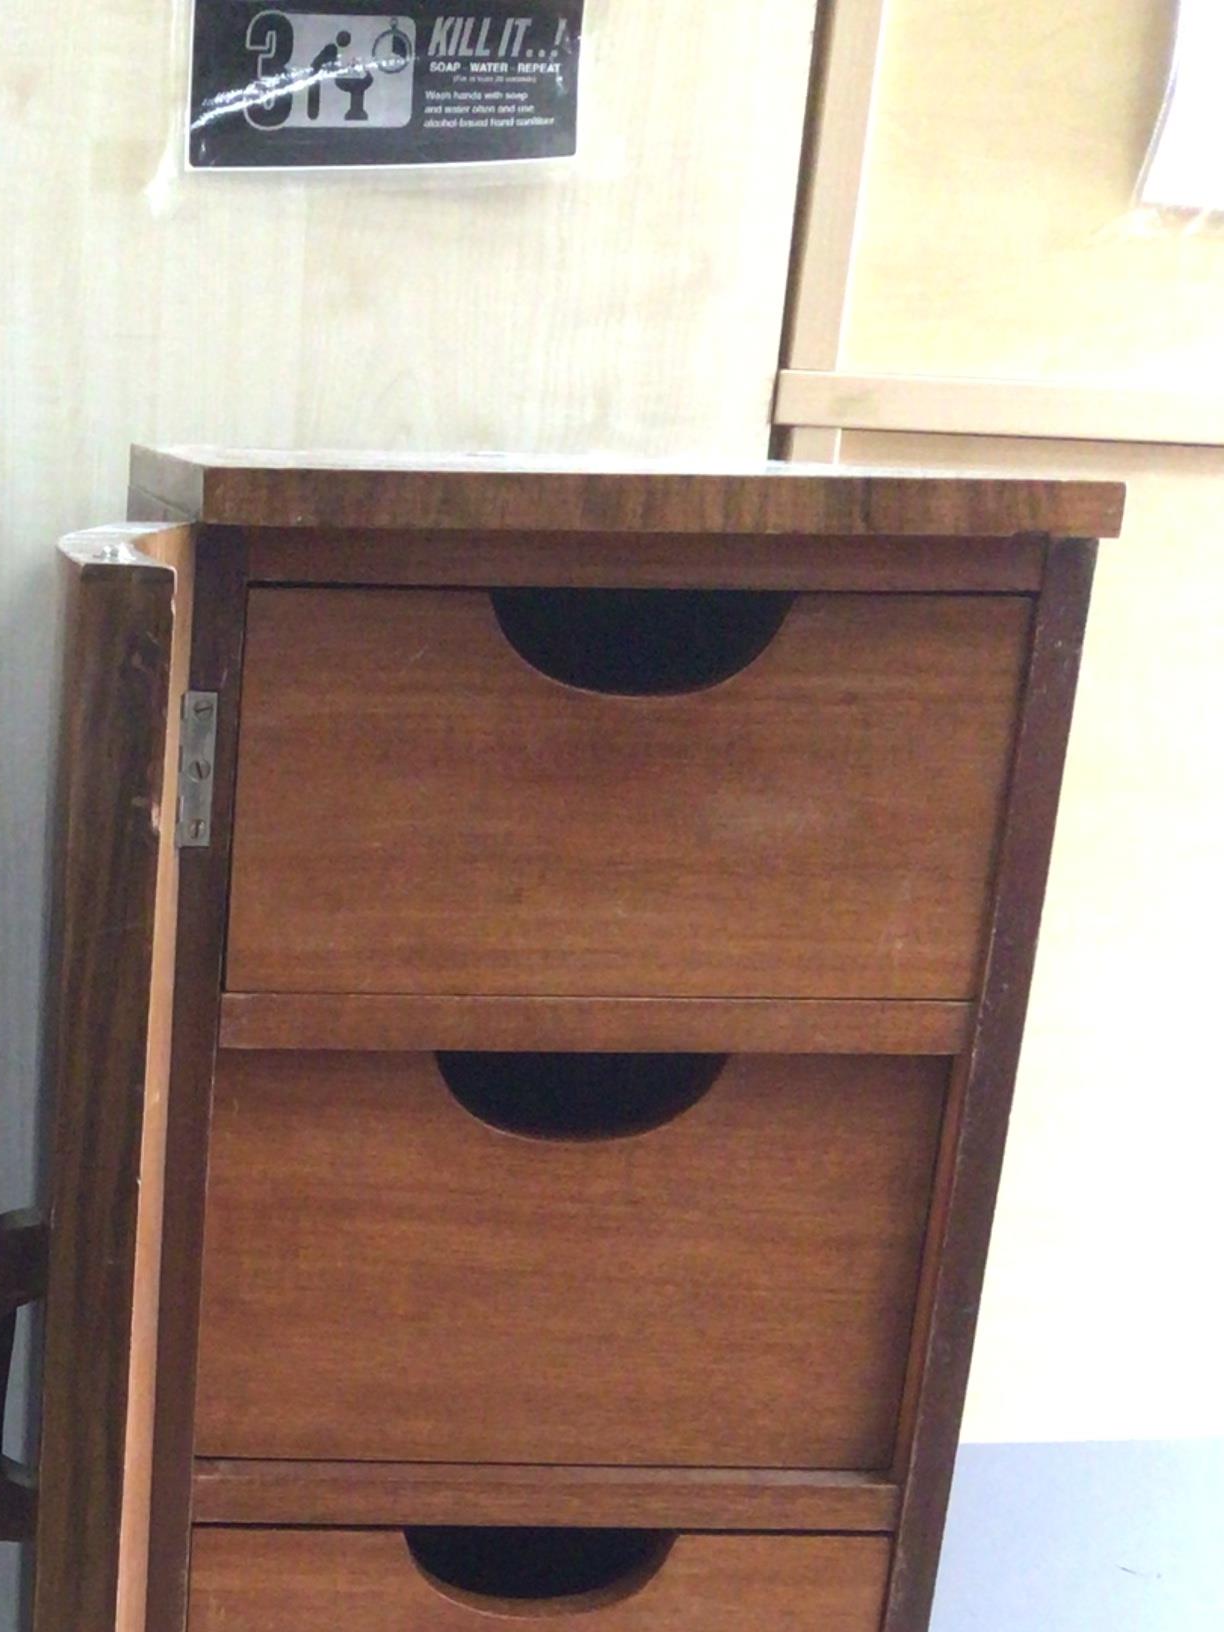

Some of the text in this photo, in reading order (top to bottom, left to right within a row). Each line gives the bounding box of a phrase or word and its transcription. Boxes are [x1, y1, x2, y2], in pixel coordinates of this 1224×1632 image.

[427, 16, 491, 56] KILL
[429, 61, 561, 73] SOAP WATER REPEAT
[425, 90, 451, 100] Wash
[453, 91, 482, 100] hands
[505, 91, 528, 101] soap
[424, 105, 442, 114] and
[444, 105, 470, 113] water
[497, 105, 515, 113] and
